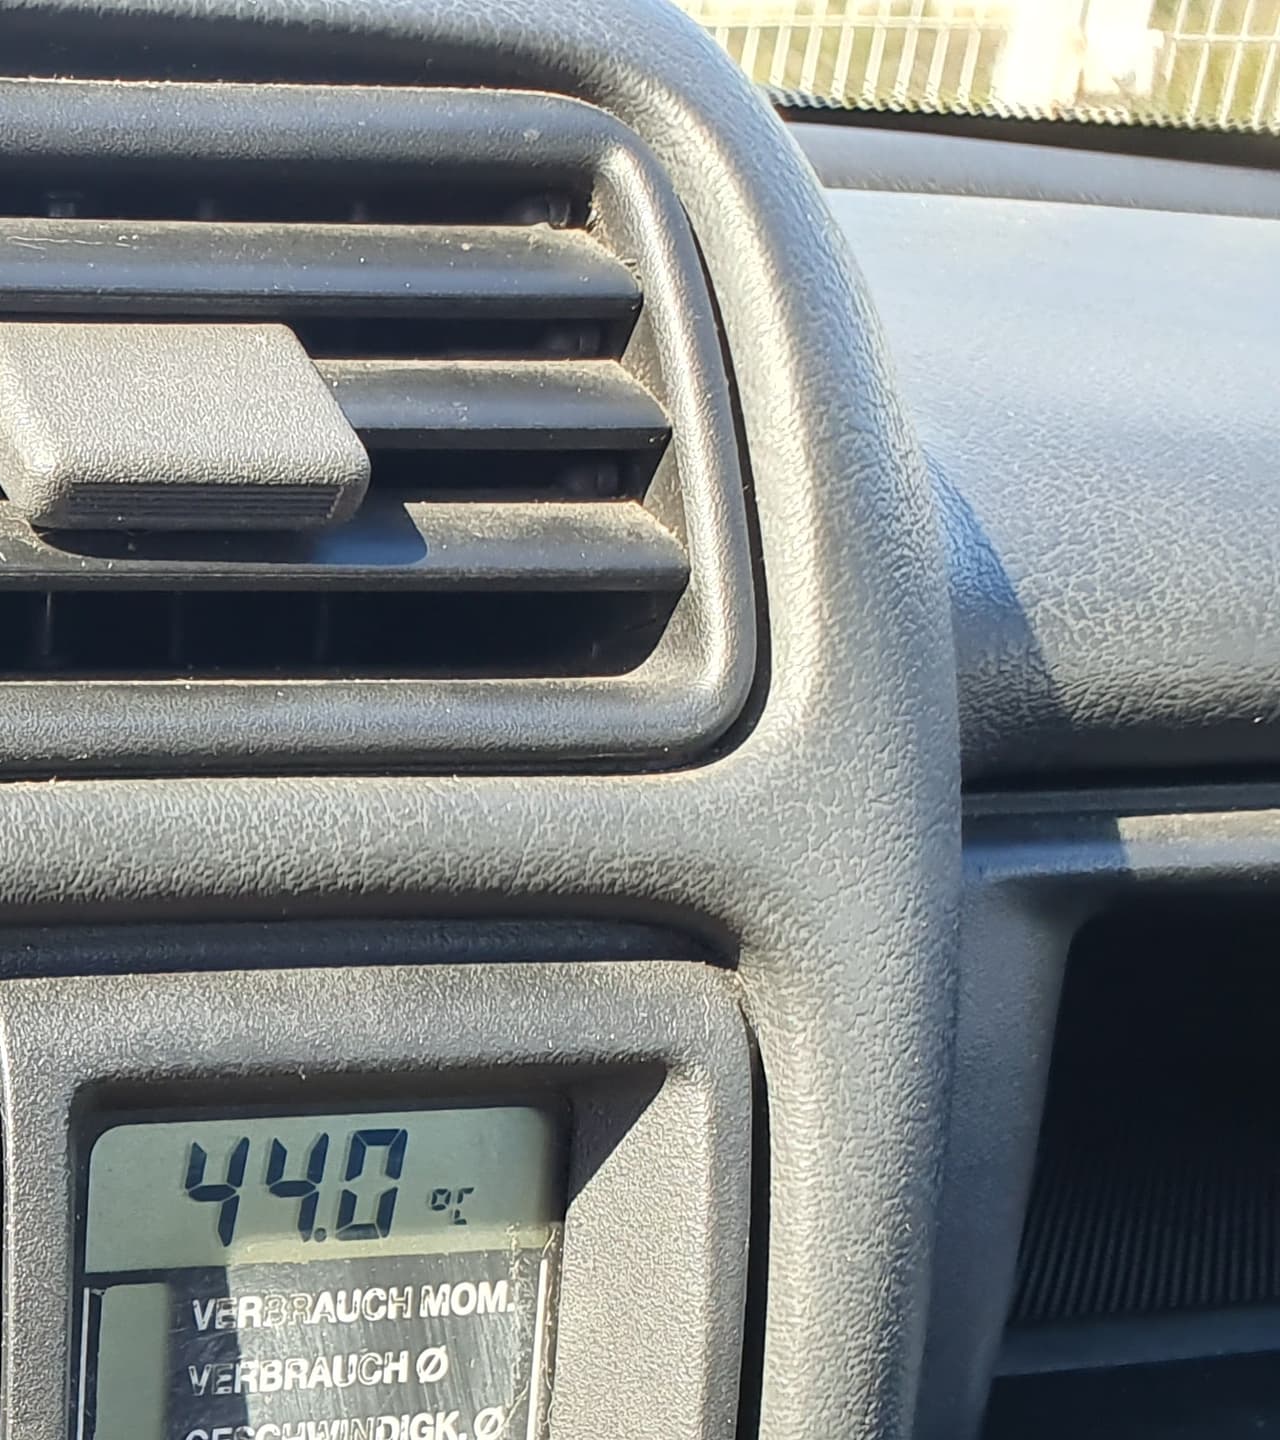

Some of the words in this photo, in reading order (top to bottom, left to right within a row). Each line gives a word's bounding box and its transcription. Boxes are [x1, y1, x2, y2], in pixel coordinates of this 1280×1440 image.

[185, 1129, 408, 1247] 44.0
[192, 1286, 411, 1331] VERBRAUCH
[420, 1279, 516, 1319] MOM.
[188, 1351, 408, 1397] VERBRAUCH
